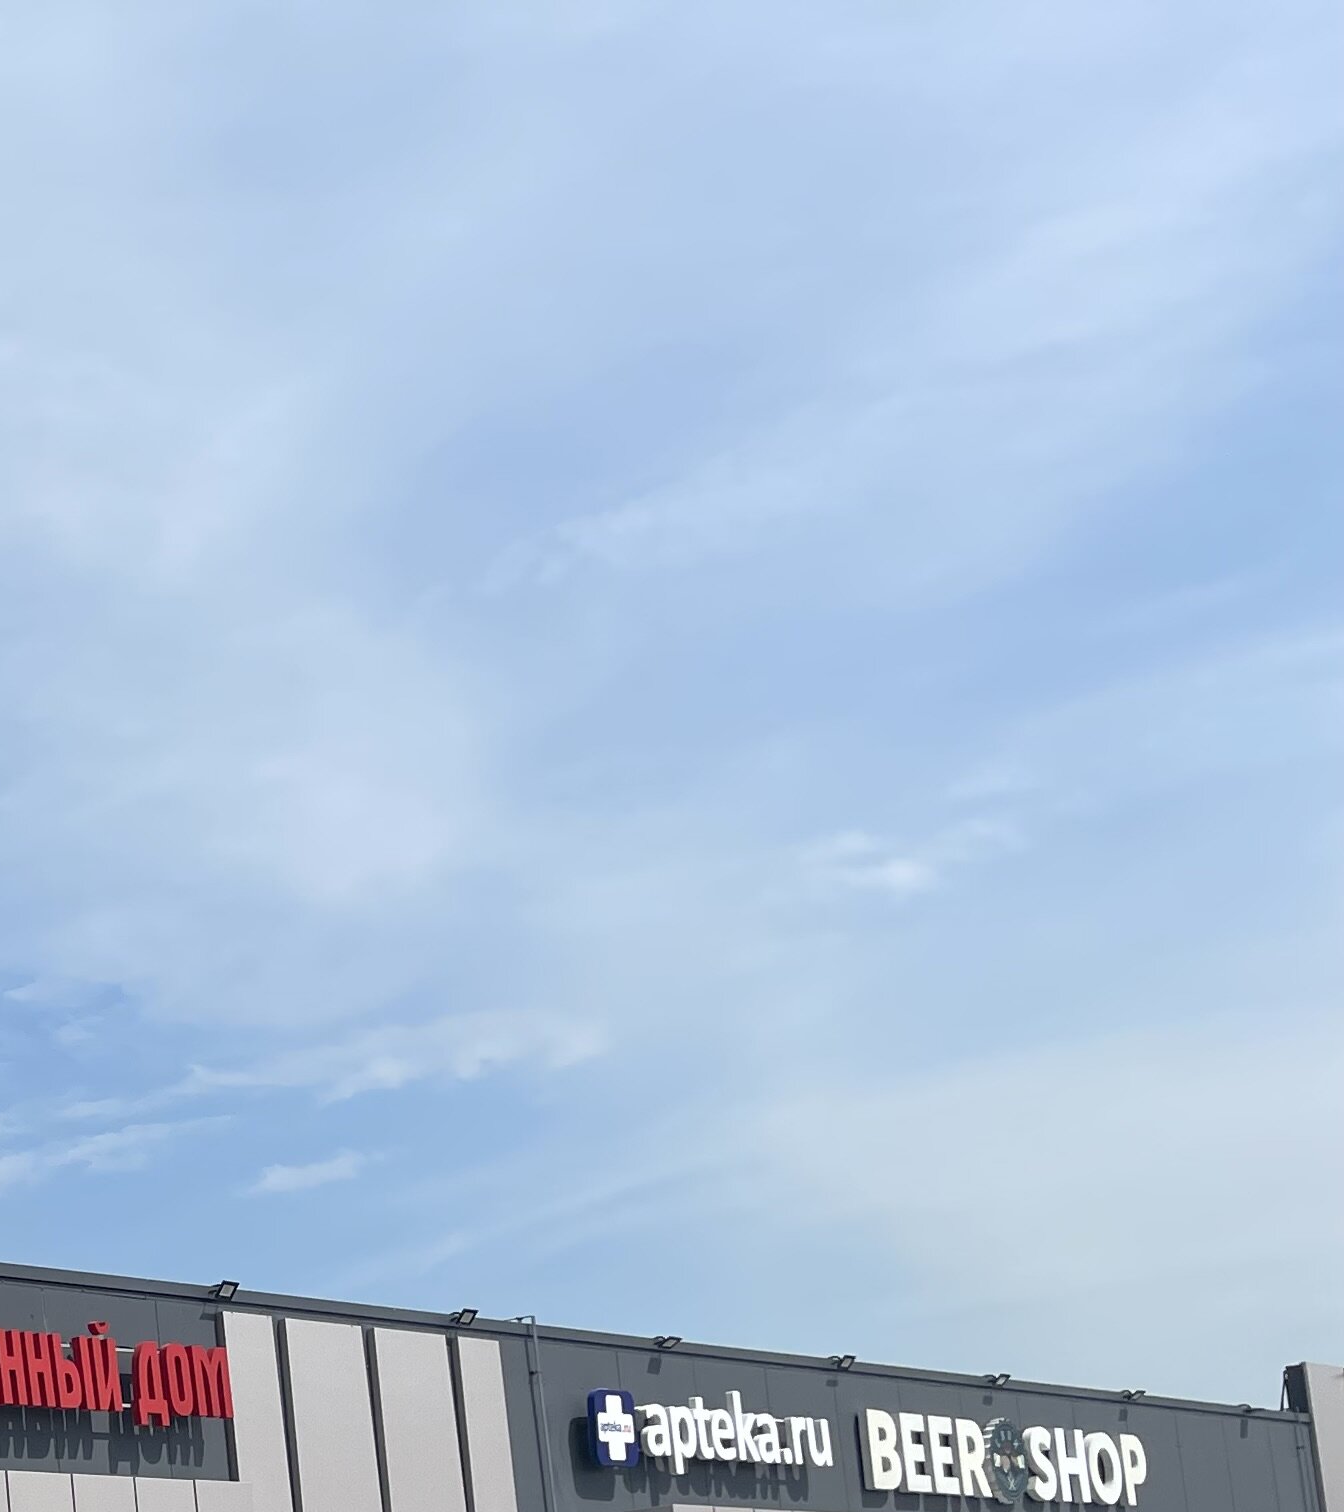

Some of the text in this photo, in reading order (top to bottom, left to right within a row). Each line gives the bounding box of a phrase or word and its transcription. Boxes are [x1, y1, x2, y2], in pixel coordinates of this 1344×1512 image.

[131, 1340, 234, 1427] ДОМ
[641, 1390, 834, 1476] apteka.ru
[863, 1408, 1147, 1507] BEER SHOP
